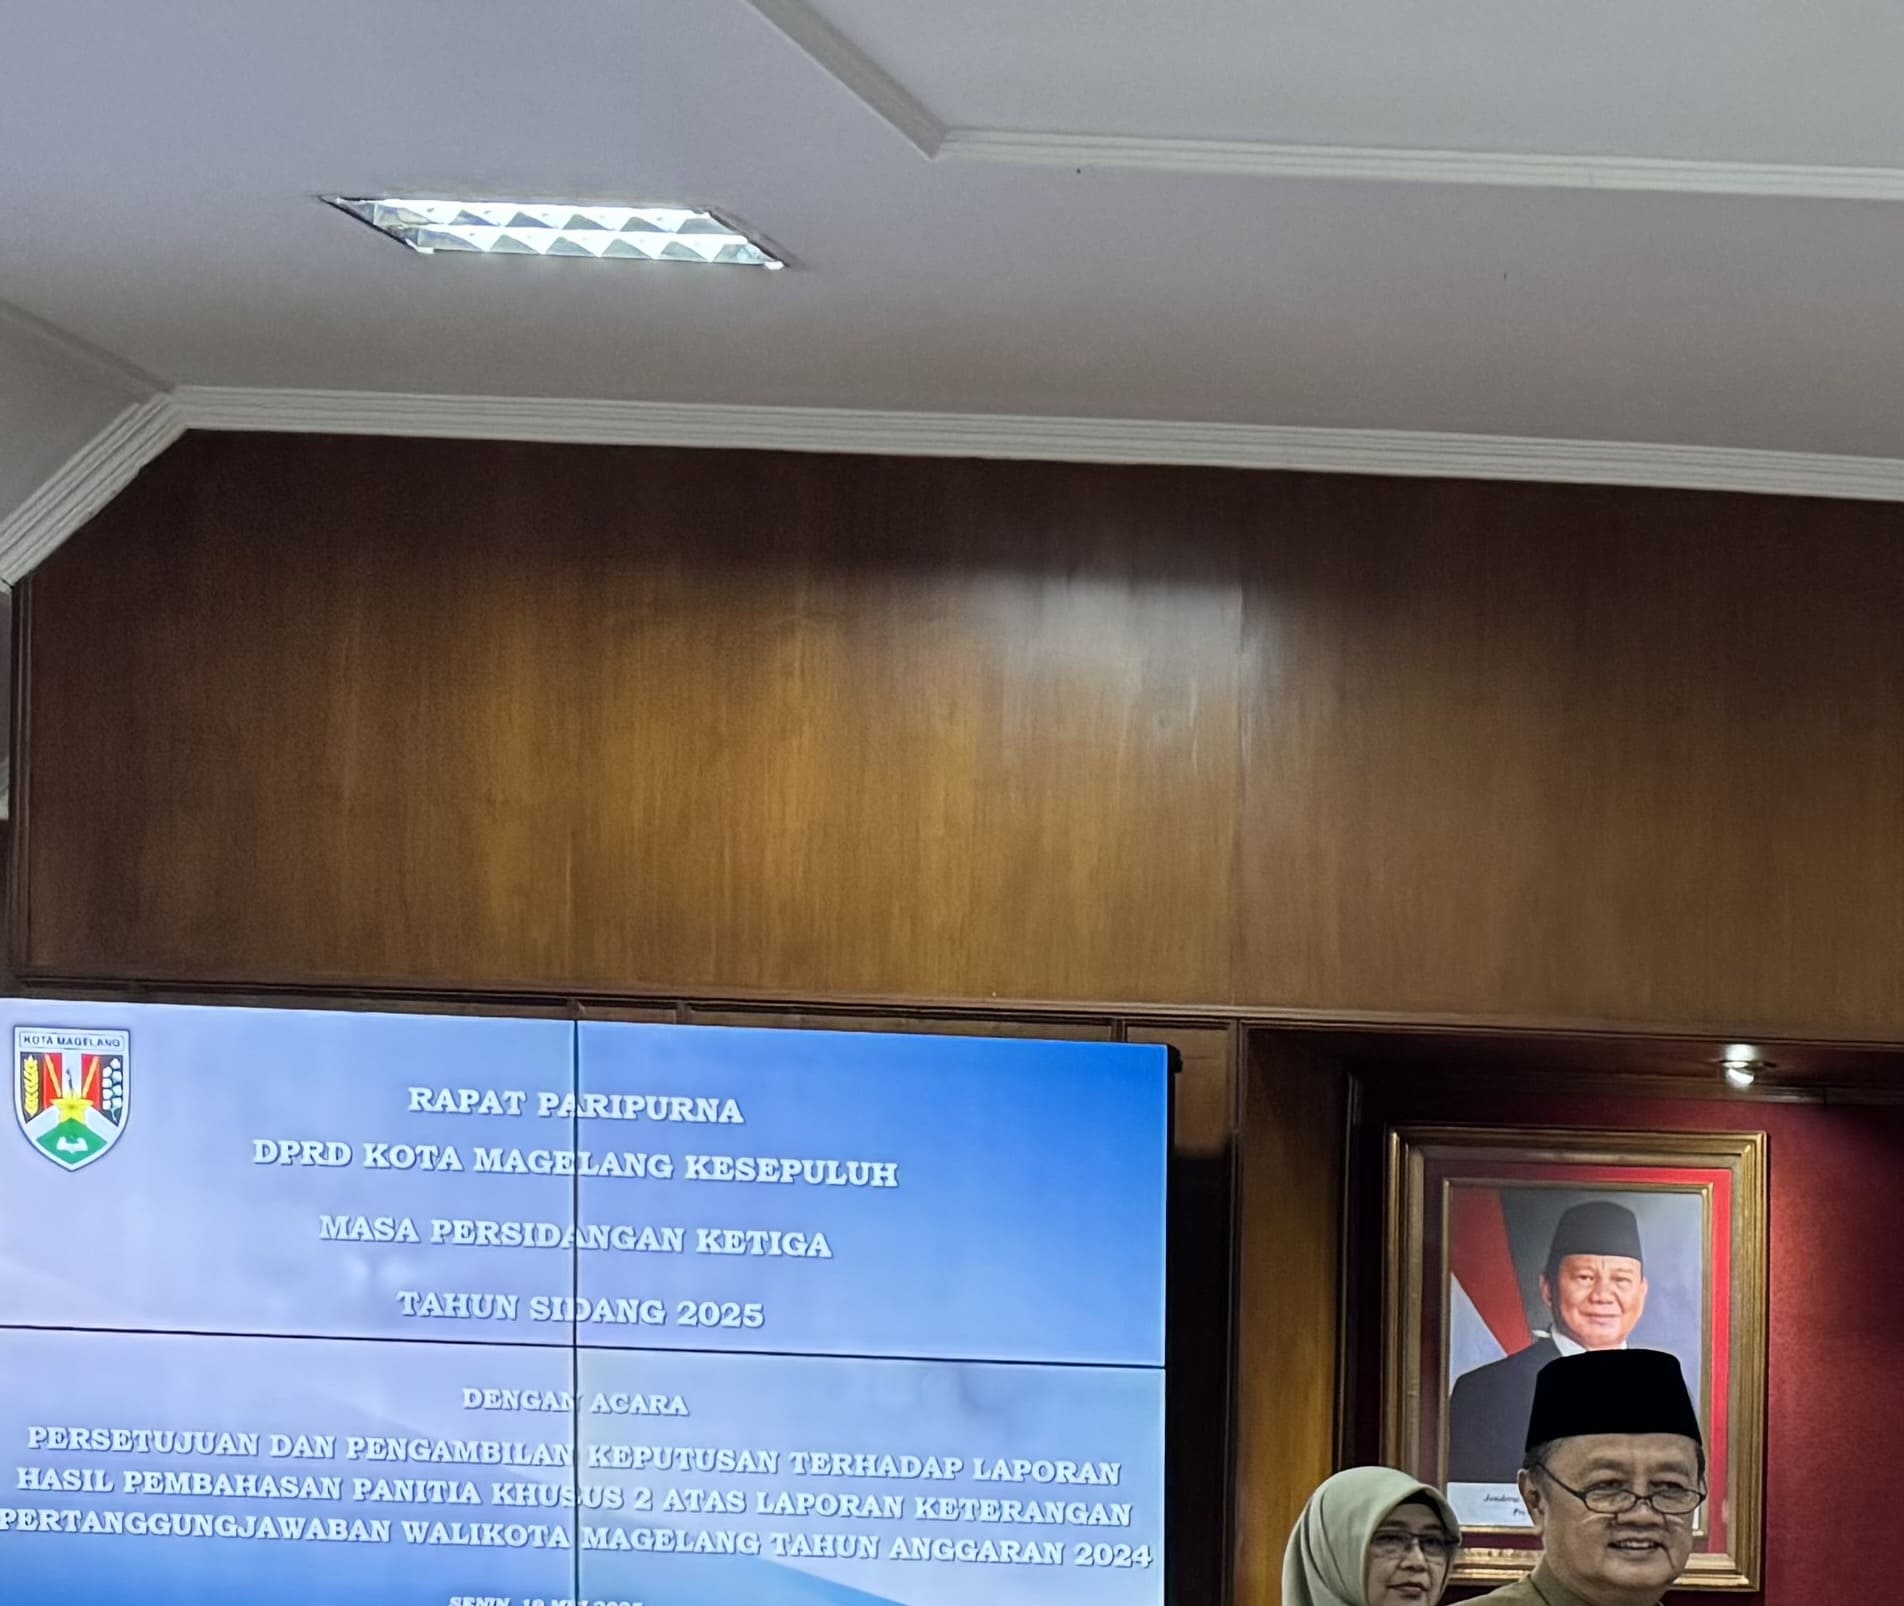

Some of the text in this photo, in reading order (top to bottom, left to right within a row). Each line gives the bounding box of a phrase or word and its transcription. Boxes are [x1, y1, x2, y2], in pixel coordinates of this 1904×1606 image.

[23, 1034, 121, 1048] KOTA MAGELANG
[408, 1086, 744, 1124] RAPAT PARIPURNA
[253, 1139, 898, 1188] DPRD KOTA MAGELANG KESEPULUH
[319, 1215, 833, 1259] MASA PERSIDANGAN KETIGA
[396, 1291, 764, 1328] TAHUN SIDANG 2025
[463, 1388, 689, 1416] DENGAN ACARA
[27, 1426, 1122, 1486] PERSETUJUAN DAN PENGAMBILAN KEPUTUSAN TERHADAP LAPORAN
[16, 1467, 1132, 1527] HASIL PEMBAHASAN PANITIA KHUSUS 2 ATAS LAPORAN KETERANGAN
[0, 1507, 1153, 1568] PERTANGGUNGJAWABAN WALIKOTA MAGELANG TAHUN ANGGARAN 2024
